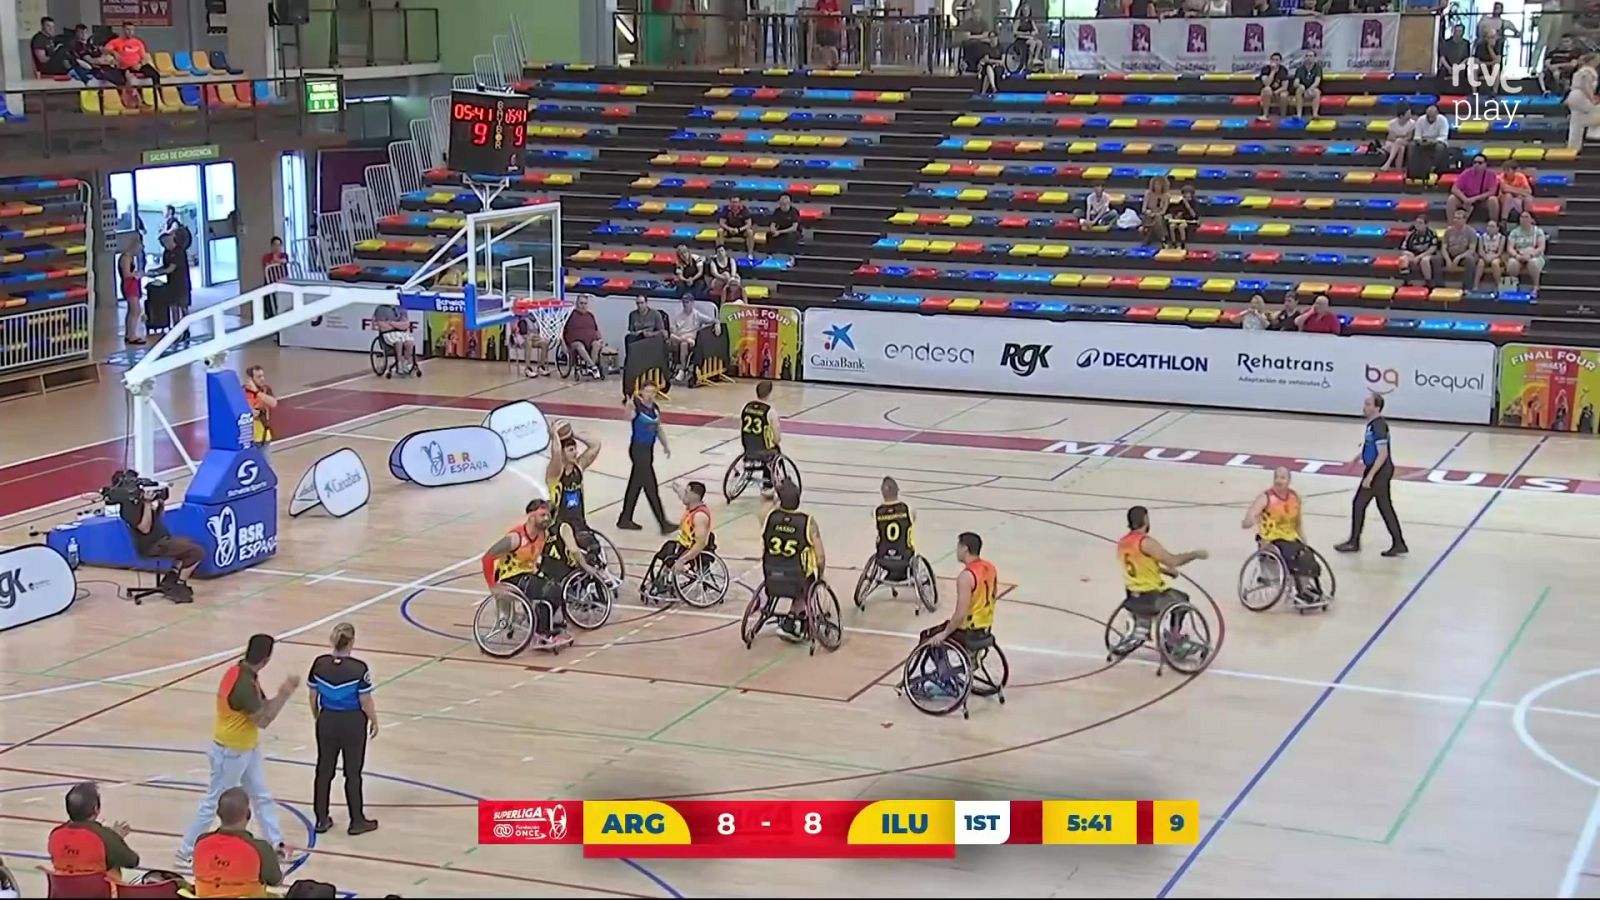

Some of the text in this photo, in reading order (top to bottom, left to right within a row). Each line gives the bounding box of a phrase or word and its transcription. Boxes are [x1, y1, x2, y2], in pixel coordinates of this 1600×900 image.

[454, 104, 493, 121] 05:41
[474, 123, 488, 144] 9
[514, 125, 524, 145] 9
[727, 309, 759, 322] FINAL
[761, 309, 791, 326] FOUR
[810, 354, 865, 370] CaixaBank
[884, 342, 975, 364] endesa
[1102, 352, 1208, 372] DECATHLON
[1511, 350, 1553, 366] FINAL
[1557, 350, 1597, 372] FOUR
[1237, 353, 1334, 374] Rehatrans
[1414, 369, 1485, 393] bequal
[743, 415, 762, 435] 23
[447, 451, 471, 464] BR
[238, 522, 264, 547] BSR
[886, 522, 900, 541] 0
[769, 536, 798, 557] 35
